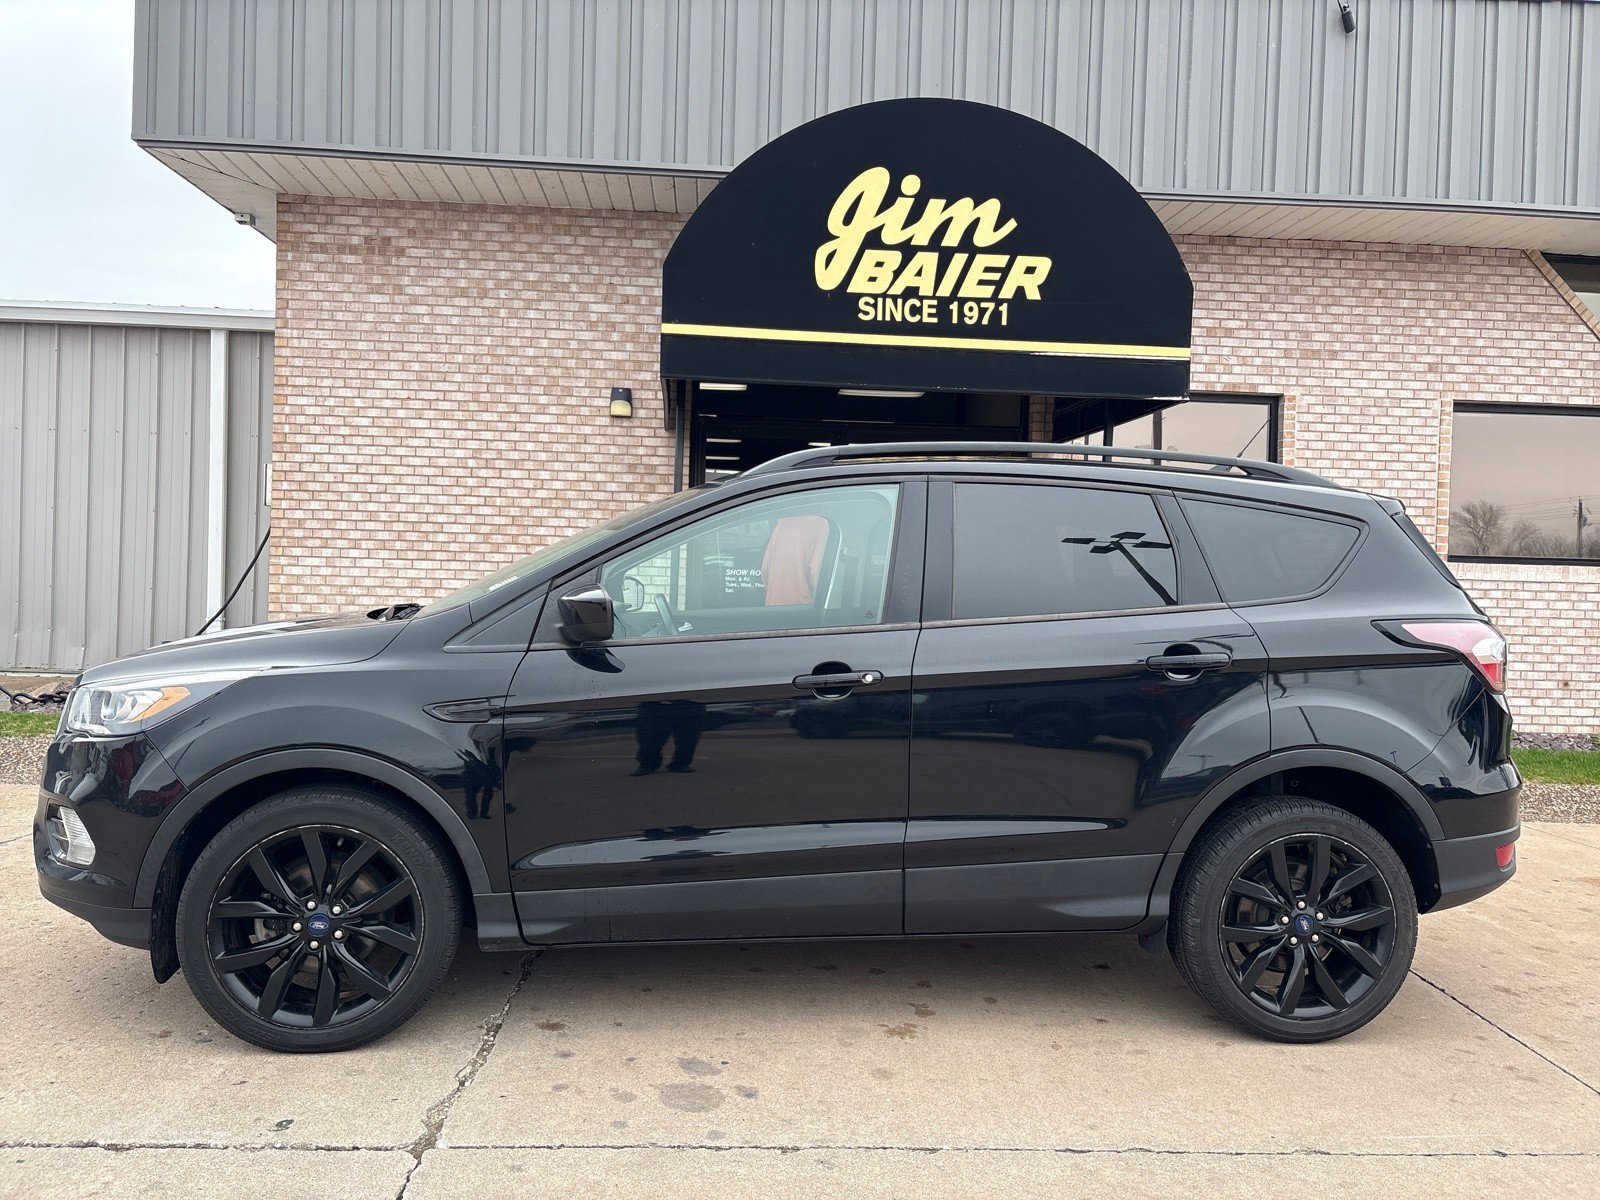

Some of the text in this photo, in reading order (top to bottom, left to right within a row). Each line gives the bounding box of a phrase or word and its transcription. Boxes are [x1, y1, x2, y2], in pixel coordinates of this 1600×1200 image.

[814, 166, 1018, 291] Jim
[846, 249, 1053, 301] BAIER
[857, 296, 1008, 326] SINCE 1971
[388, 830, 430, 875] KENDA
[310, 921, 328, 930] Ford
